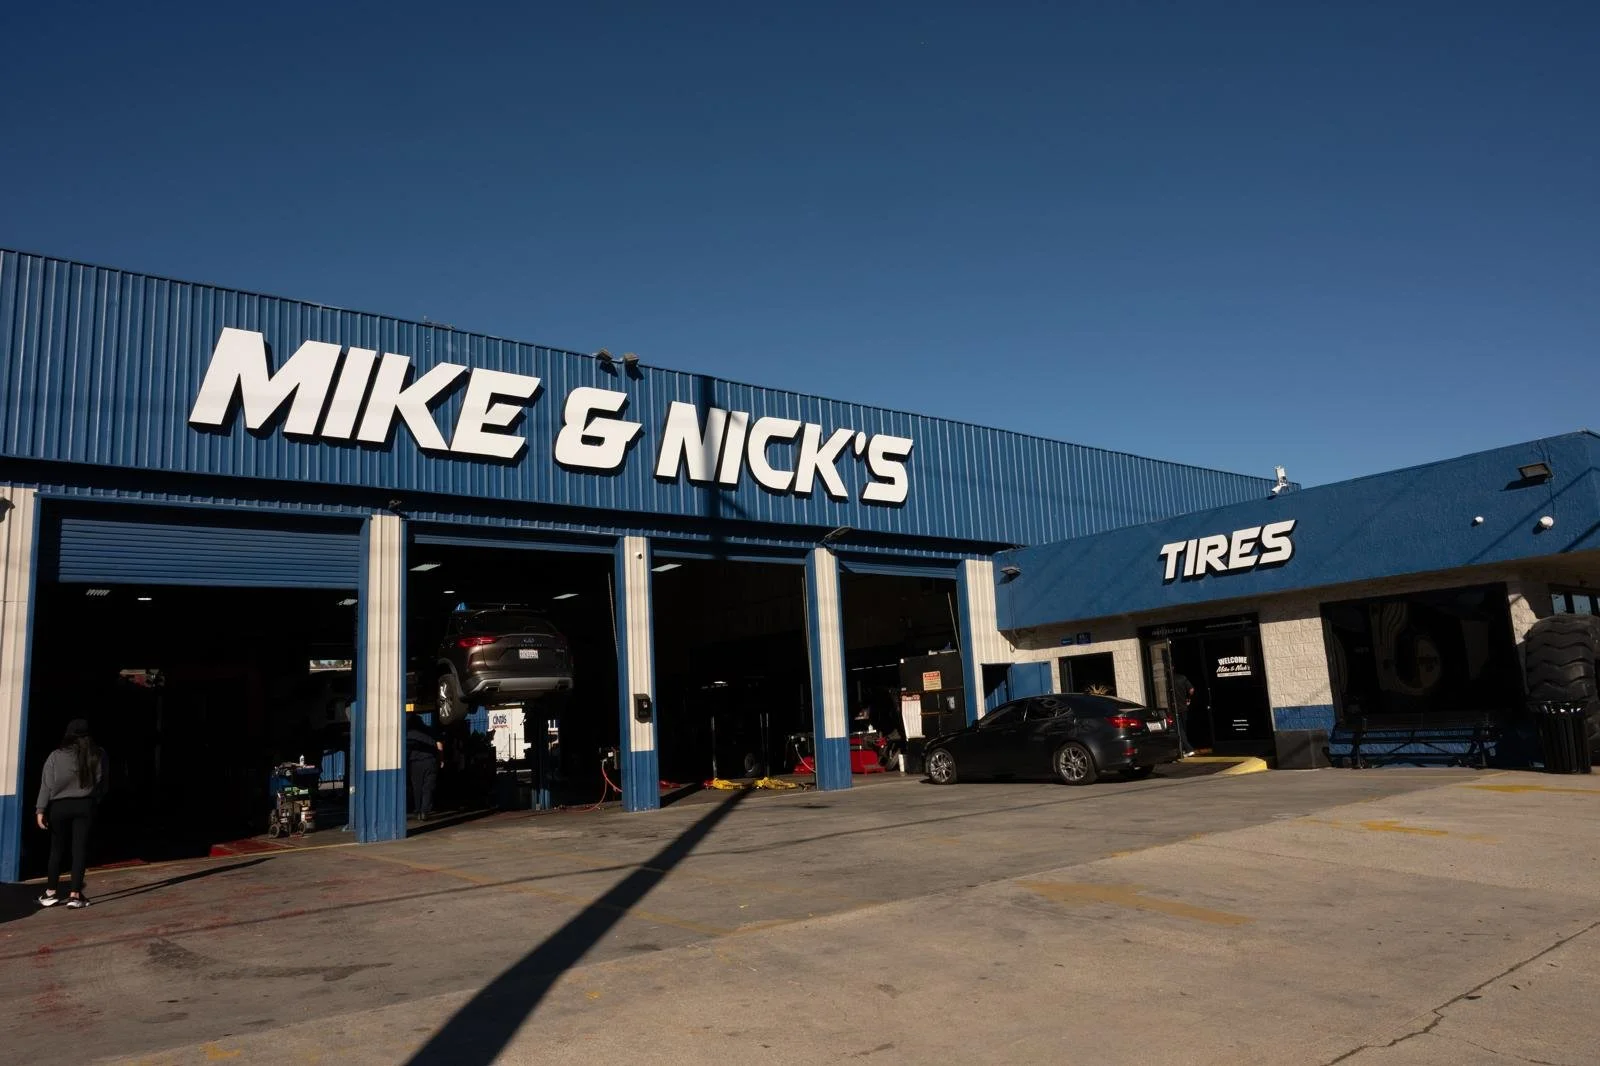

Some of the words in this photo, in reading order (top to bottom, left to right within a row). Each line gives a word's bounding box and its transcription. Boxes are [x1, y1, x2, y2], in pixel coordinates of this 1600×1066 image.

[189, 327, 540, 459] MIKE
[555, 387, 642, 469] &
[656, 400, 914, 503] NICK'S
[1160, 520, 1295, 579] TIRES
[1217, 656, 1248, 666] WELCOME
